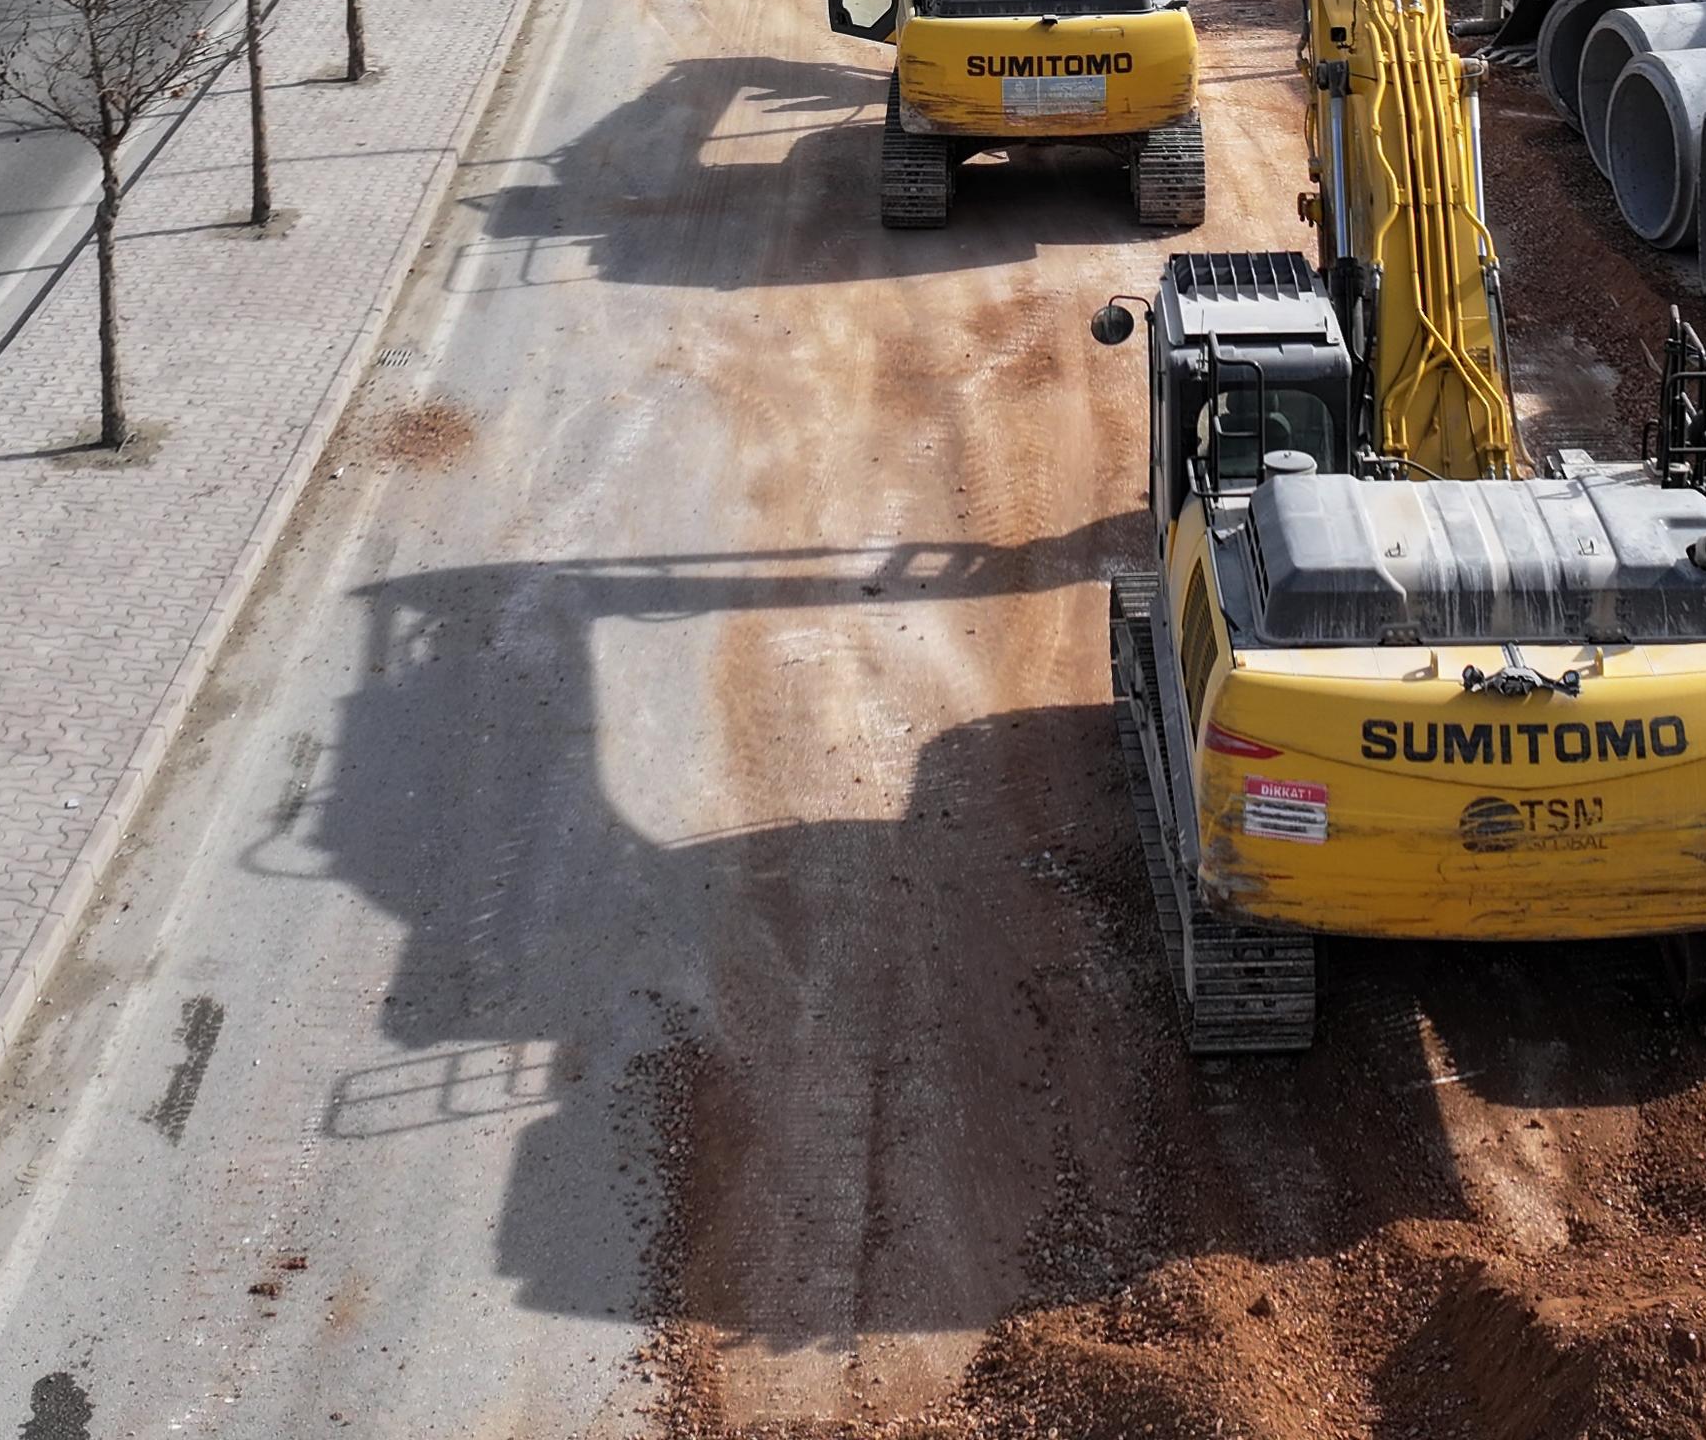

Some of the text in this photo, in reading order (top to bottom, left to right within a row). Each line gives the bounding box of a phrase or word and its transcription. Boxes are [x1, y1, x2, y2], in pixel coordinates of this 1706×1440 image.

[966, 52, 1133, 77] SUMITOMO
[1361, 715, 1689, 764] SUMITOMO
[1519, 796, 1603, 832] TSM
